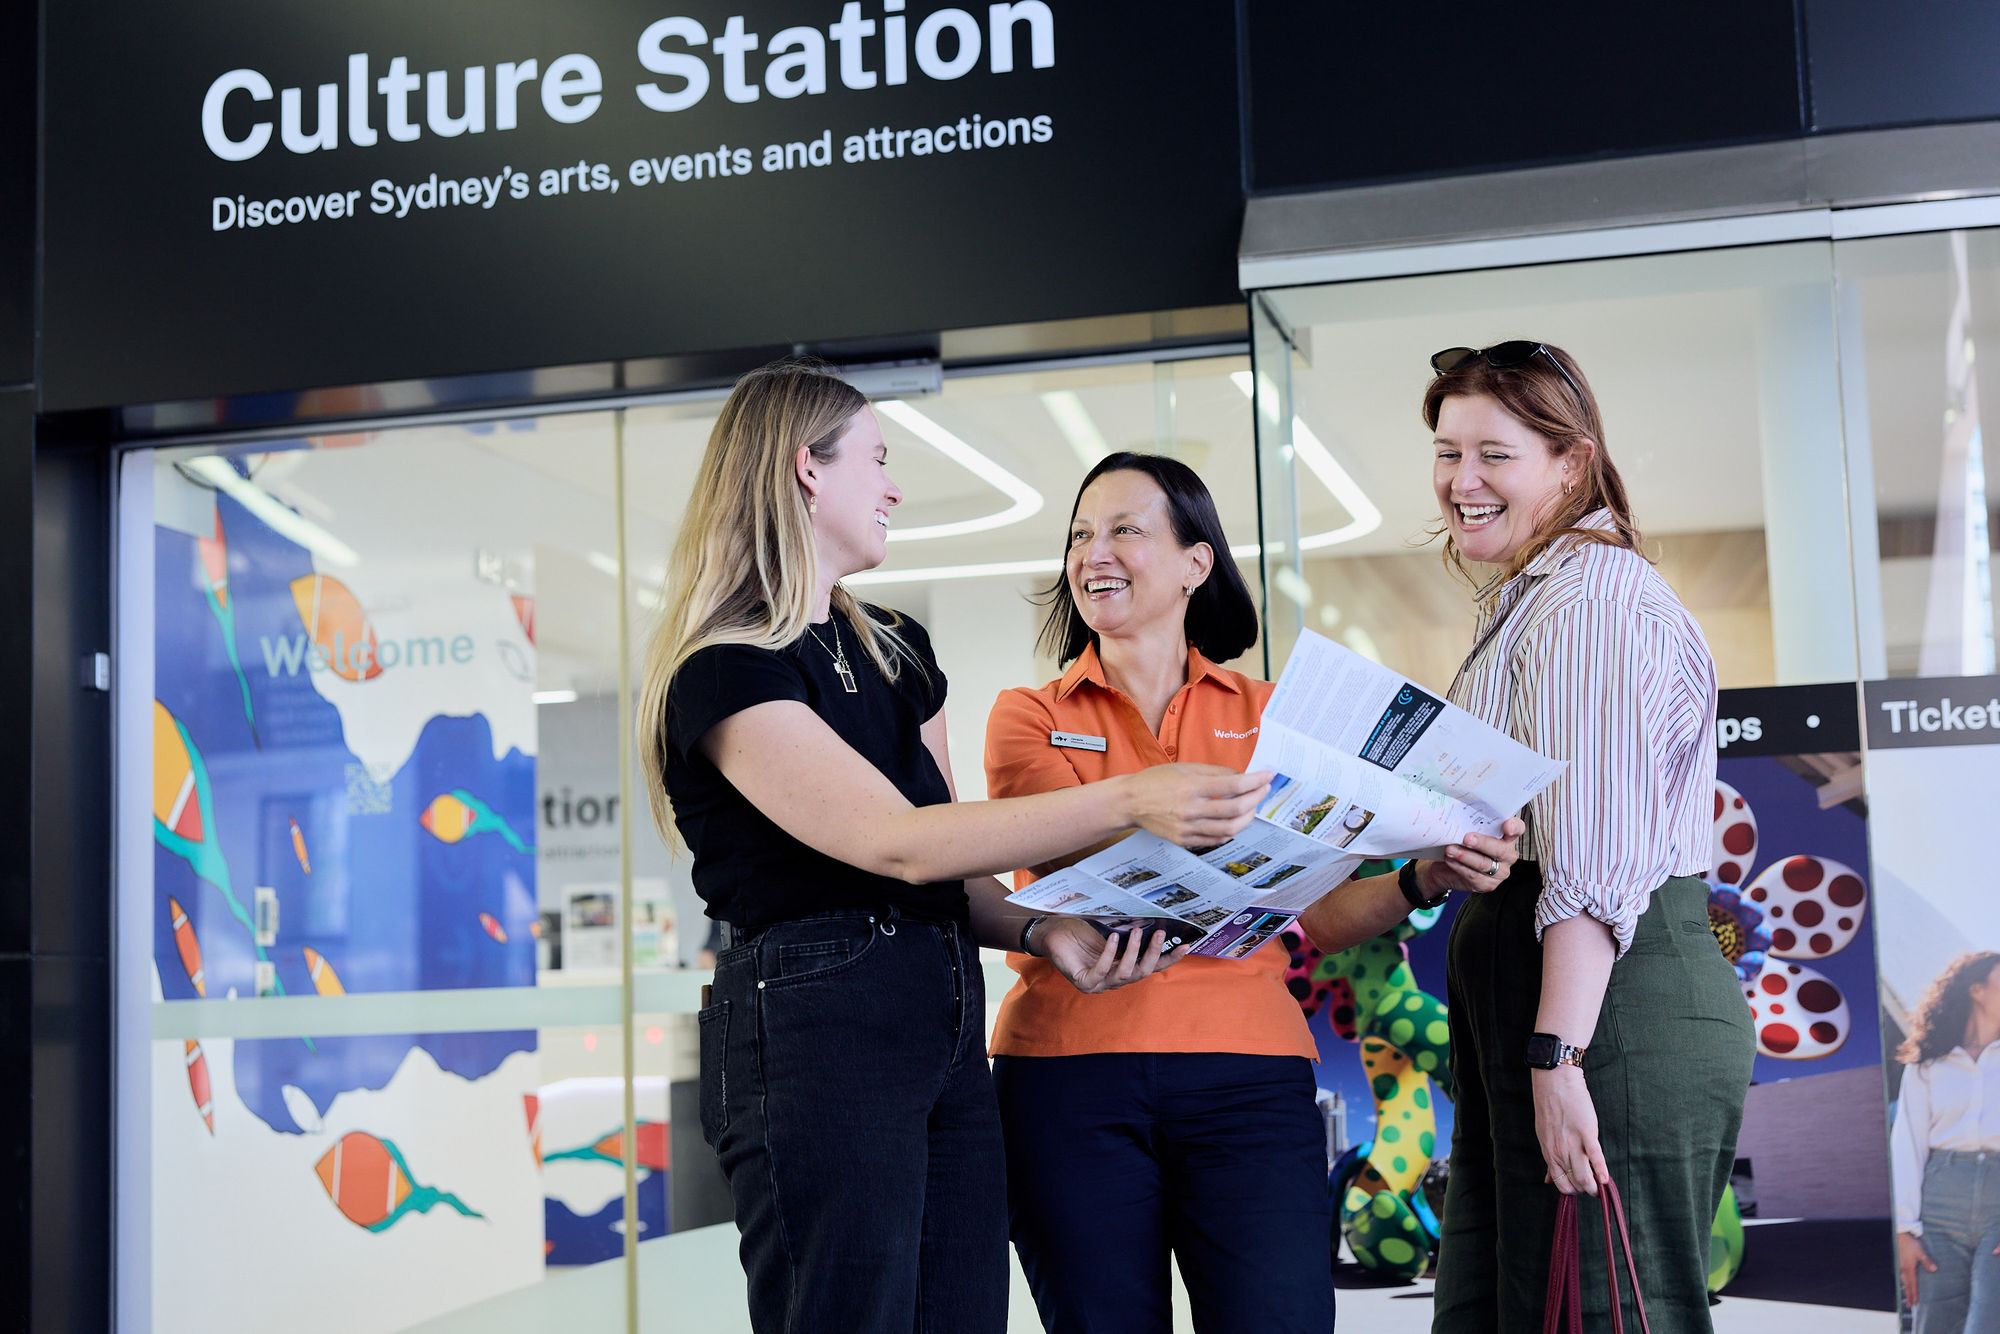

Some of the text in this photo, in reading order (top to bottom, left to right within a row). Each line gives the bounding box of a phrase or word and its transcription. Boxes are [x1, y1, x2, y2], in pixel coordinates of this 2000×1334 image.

[202, 0, 1055, 161] Culture Station
[212, 113, 1054, 231] Discover Sydney's arts, events and attractions
[259, 632, 475, 678] Welcome
[1214, 727, 1259, 740] Welcome
